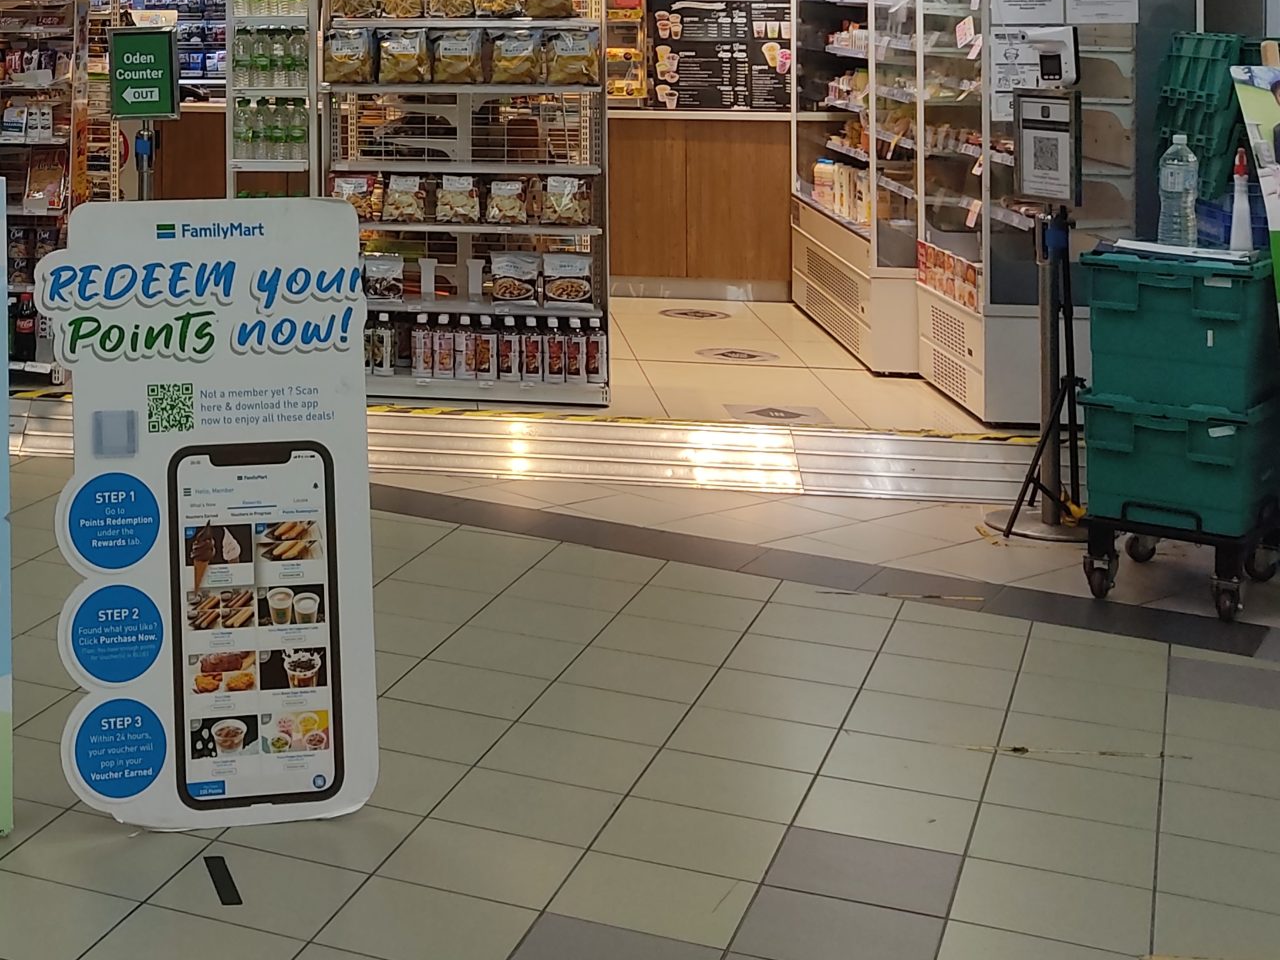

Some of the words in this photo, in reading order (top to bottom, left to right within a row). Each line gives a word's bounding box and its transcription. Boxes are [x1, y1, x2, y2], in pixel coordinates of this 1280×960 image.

[124, 53, 154, 64] Oden
[116, 68, 163, 80] Counter
[133, 91, 154, 100] OUT
[181, 222, 264, 240] FamilyMart
[49, 261, 236, 303] REDEEM
[237, 306, 353, 347] now!
[200, 390, 216, 399] Not
[227, 388, 267, 398] member
[270, 388, 285, 399] yet
[295, 386, 319, 396] Scan
[200, 402, 222, 411] here
[235, 400, 280, 411] download
[283, 399, 299, 409] the
[301, 400, 319, 412] app
[201, 416, 220, 425] now
[222, 415, 233, 424] to
[234, 413, 260, 427] enjoy
[262, 413, 275, 423] all
[277, 412, 303, 422] these
[305, 411, 335, 421] deals!
[95, 491, 126, 504] STEP
[105, 507, 116, 515] Go
[80, 519, 104, 528] Points
[106, 516, 153, 526] Redemption
[97, 529, 120, 537] under
[121, 527, 134, 535] the
[91, 538, 125, 547] Rewards
[98, 609, 129, 621] STEP
[132, 608, 139, 619] 2
[78, 626, 102, 635] Found
[103, 624, 123, 633] what
[123, 625, 138, 634] you
[78, 636, 98, 646] Click
[99, 634, 136, 645] Purchase
[138, 633, 158, 642] Now.
[101, 716, 132, 730] STEP
[134, 716, 142, 727] 3
[90, 734, 114, 744] Within
[88, 748, 105, 758] your
[107, 745, 138, 754] voucher
[139, 743, 153, 751] will
[100, 760, 115, 769] pop
[125, 757, 142, 767] your
[90, 771, 123, 781] Voucher
[124, 767, 152, 778] Earned
